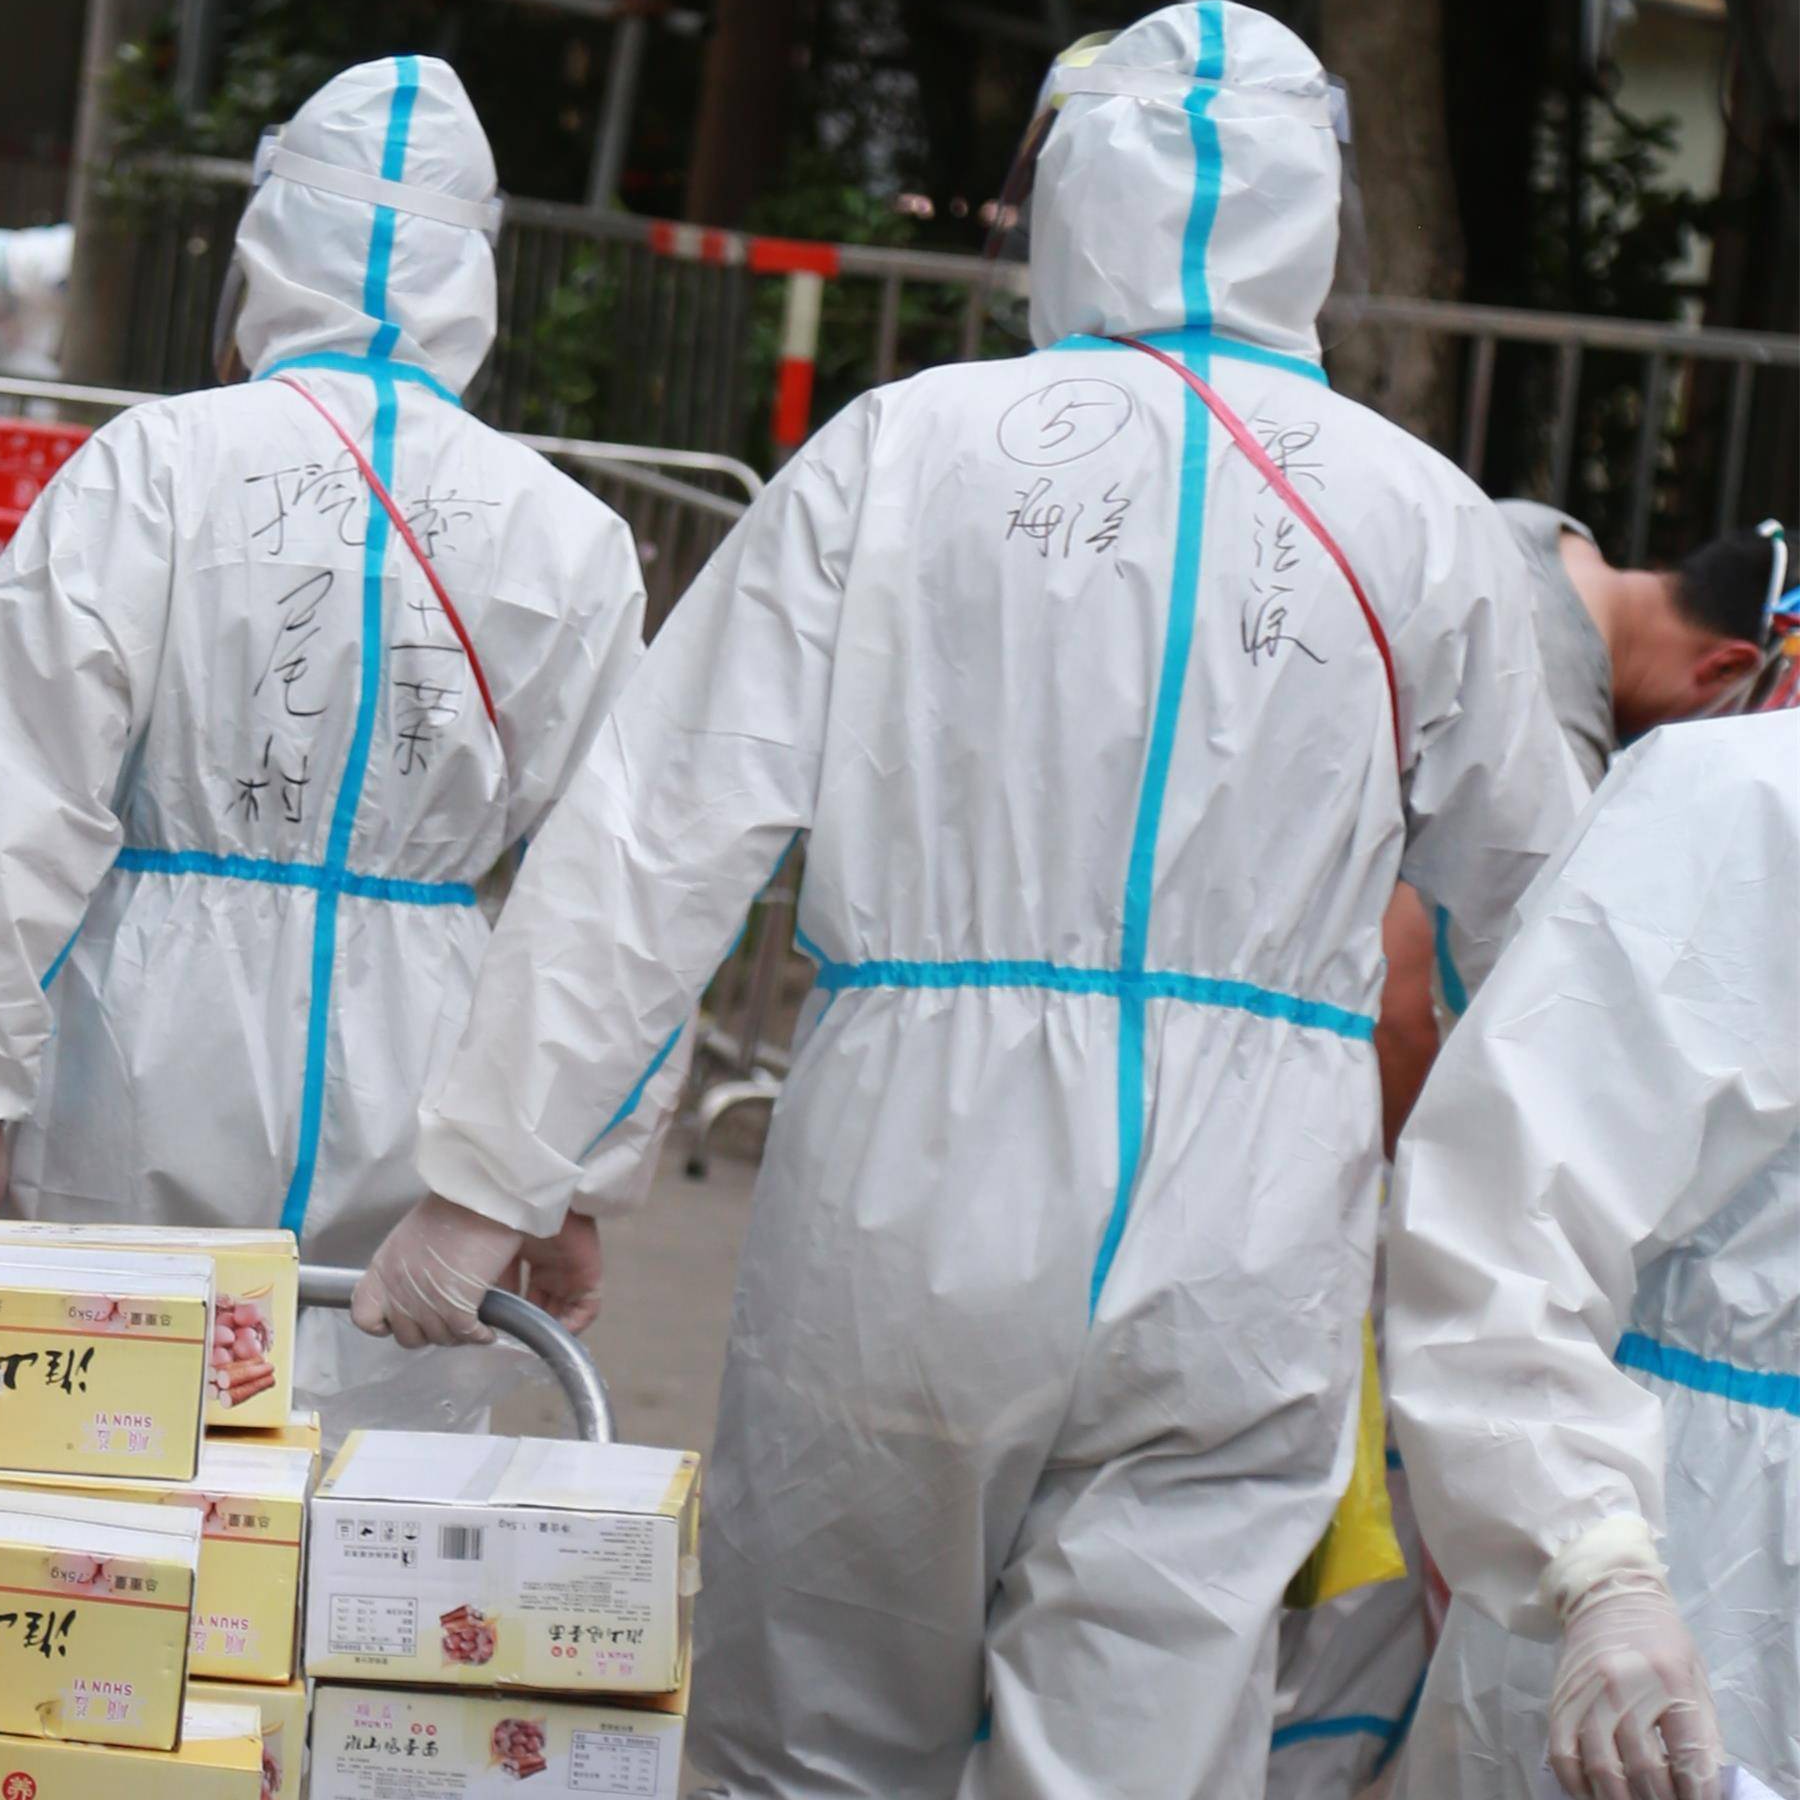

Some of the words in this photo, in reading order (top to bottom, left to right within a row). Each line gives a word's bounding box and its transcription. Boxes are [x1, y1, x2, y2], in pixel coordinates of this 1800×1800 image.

[96, 1412, 108, 1425] YI
[113, 1414, 153, 1428] SHUN
[210, 1615, 249, 1630] SHUN
[74, 1678, 87, 1693] YI
[94, 1680, 134, 1697] SHUN
